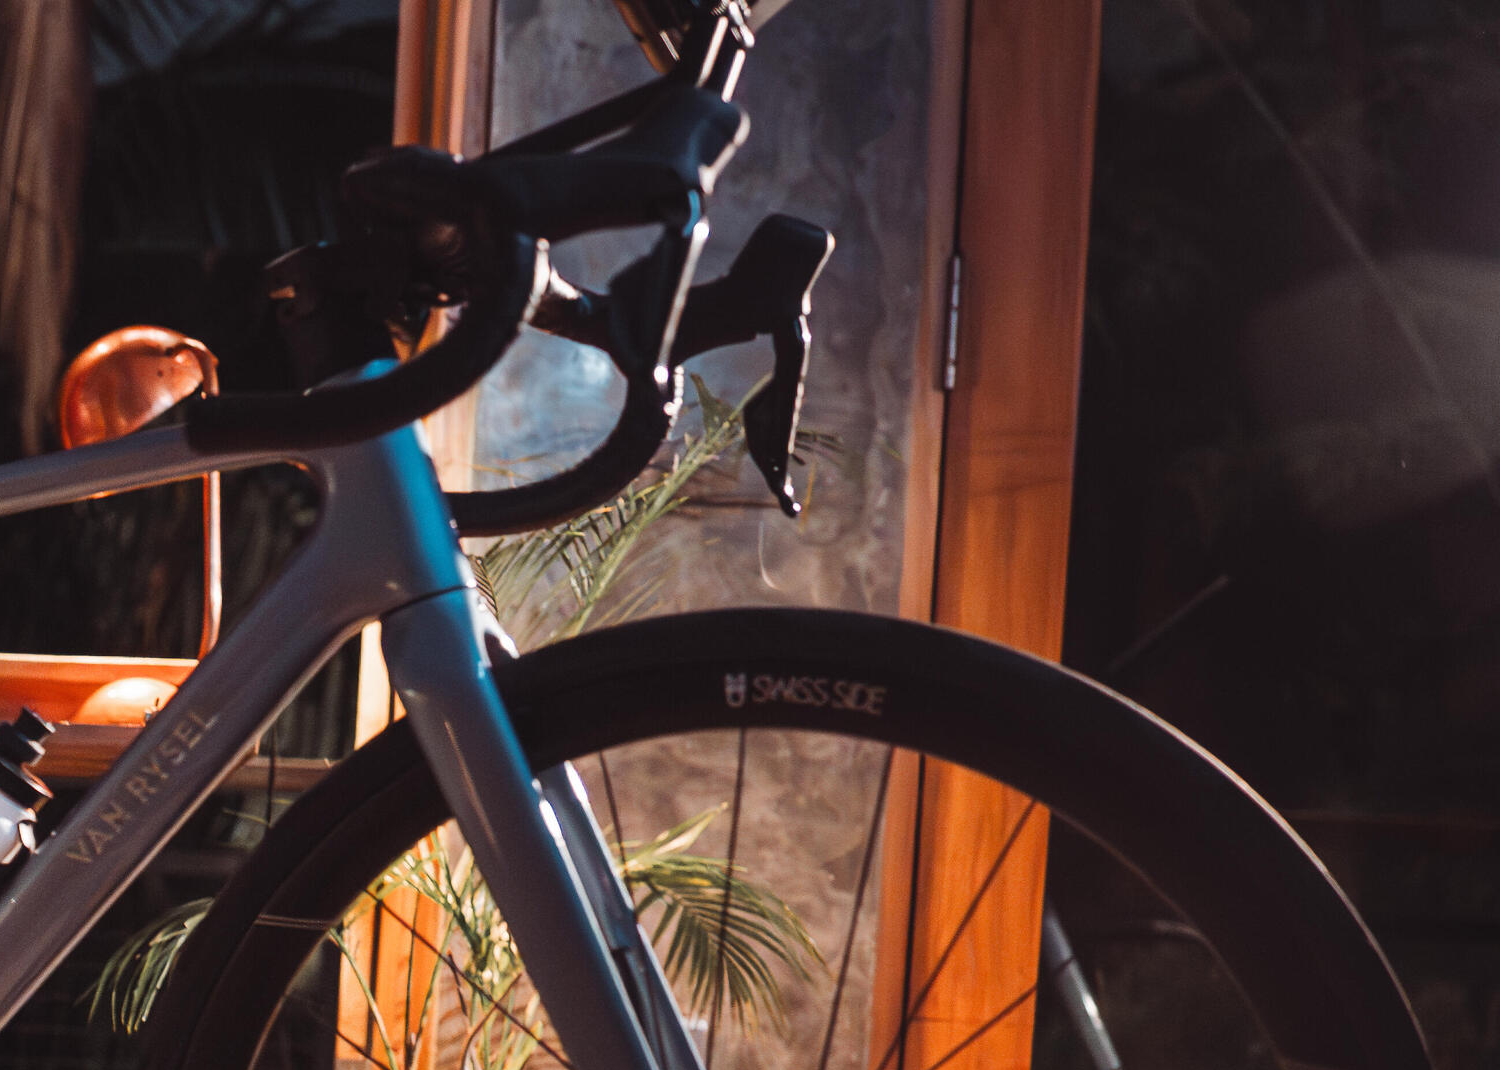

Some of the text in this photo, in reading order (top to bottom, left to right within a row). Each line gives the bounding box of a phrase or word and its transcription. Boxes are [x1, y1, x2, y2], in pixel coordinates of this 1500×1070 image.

[752, 673, 887, 715] SWISS SIDE
[65, 711, 220, 863] VAN RYSEL
